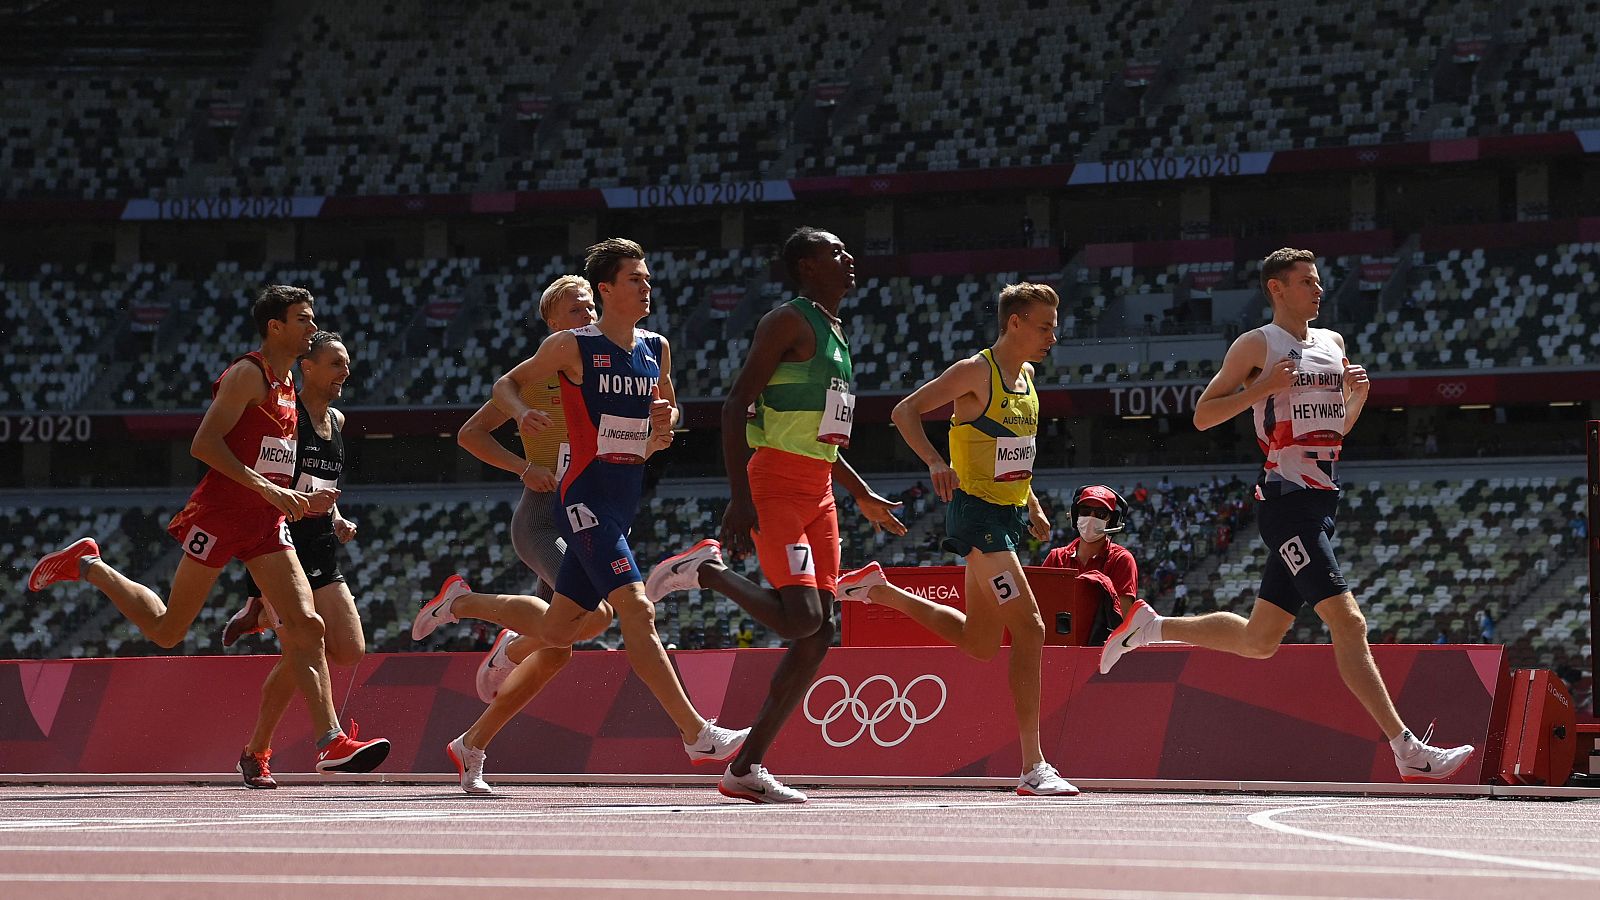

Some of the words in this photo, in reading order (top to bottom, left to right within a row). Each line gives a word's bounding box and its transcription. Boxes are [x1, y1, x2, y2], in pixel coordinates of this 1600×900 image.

[1102, 157, 1178, 184] TOKYO
[1184, 153, 1240, 179] 2020
[633, 184, 706, 207] TOKYO
[712, 181, 764, 204] 2020
[154, 198, 231, 219] TOKYO
[238, 197, 293, 218] 2020
[1291, 373, 1317, 387] REAT
[1293, 403, 1345, 419] HEYWARD
[19, 415, 91, 442] 2020
[260, 446, 297, 465] MECHA
[302, 458, 319, 469] NEW
[188, 531, 209, 555] 8
[793, 546, 809, 571] 7
[1282, 541, 1305, 570] 13
[903, 585, 960, 600] OMEGA
[992, 575, 1012, 600] 5
